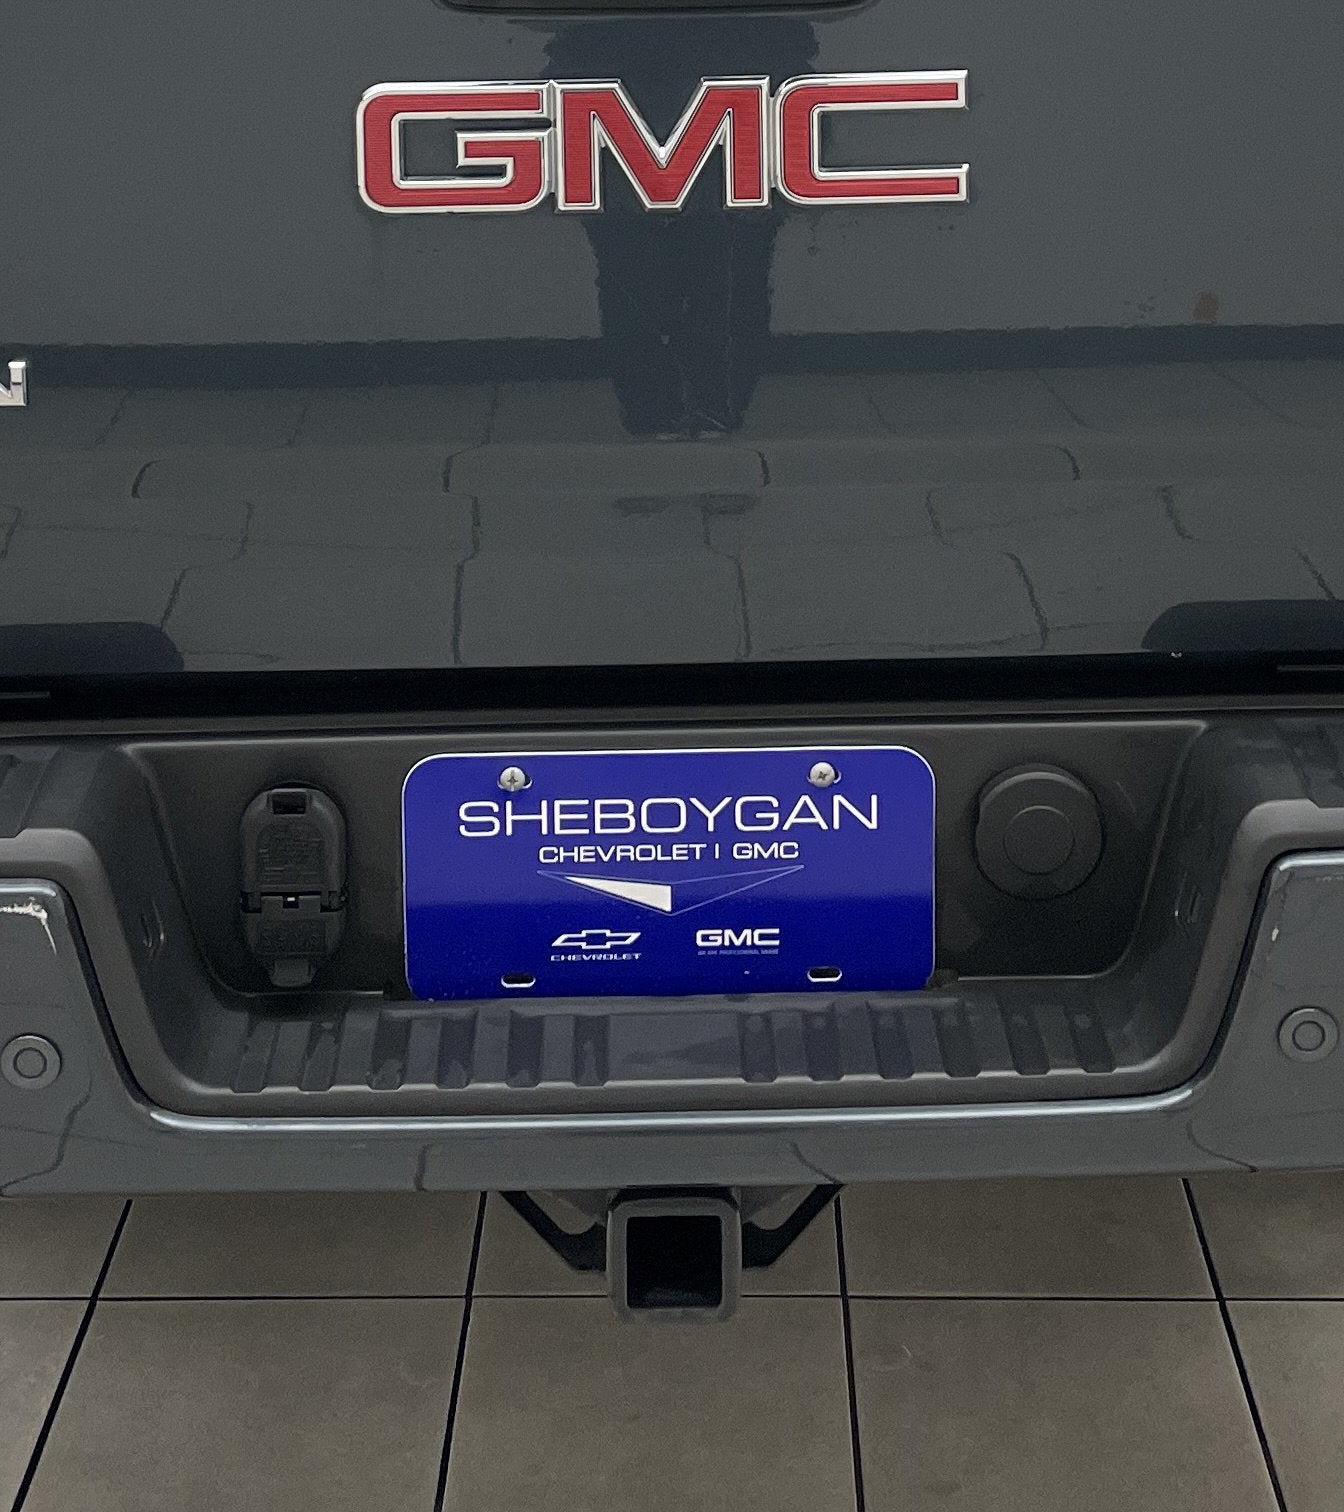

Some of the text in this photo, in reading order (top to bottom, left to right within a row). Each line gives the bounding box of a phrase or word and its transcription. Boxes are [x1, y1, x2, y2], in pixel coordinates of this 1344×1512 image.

[357, 69, 969, 213] GMC
[457, 794, 879, 838] SHEBOYGAN
[538, 841, 800, 864] CHEVROLET GMC
[696, 928, 780, 947] GMC
[550, 952, 642, 962] CHEVROLET
